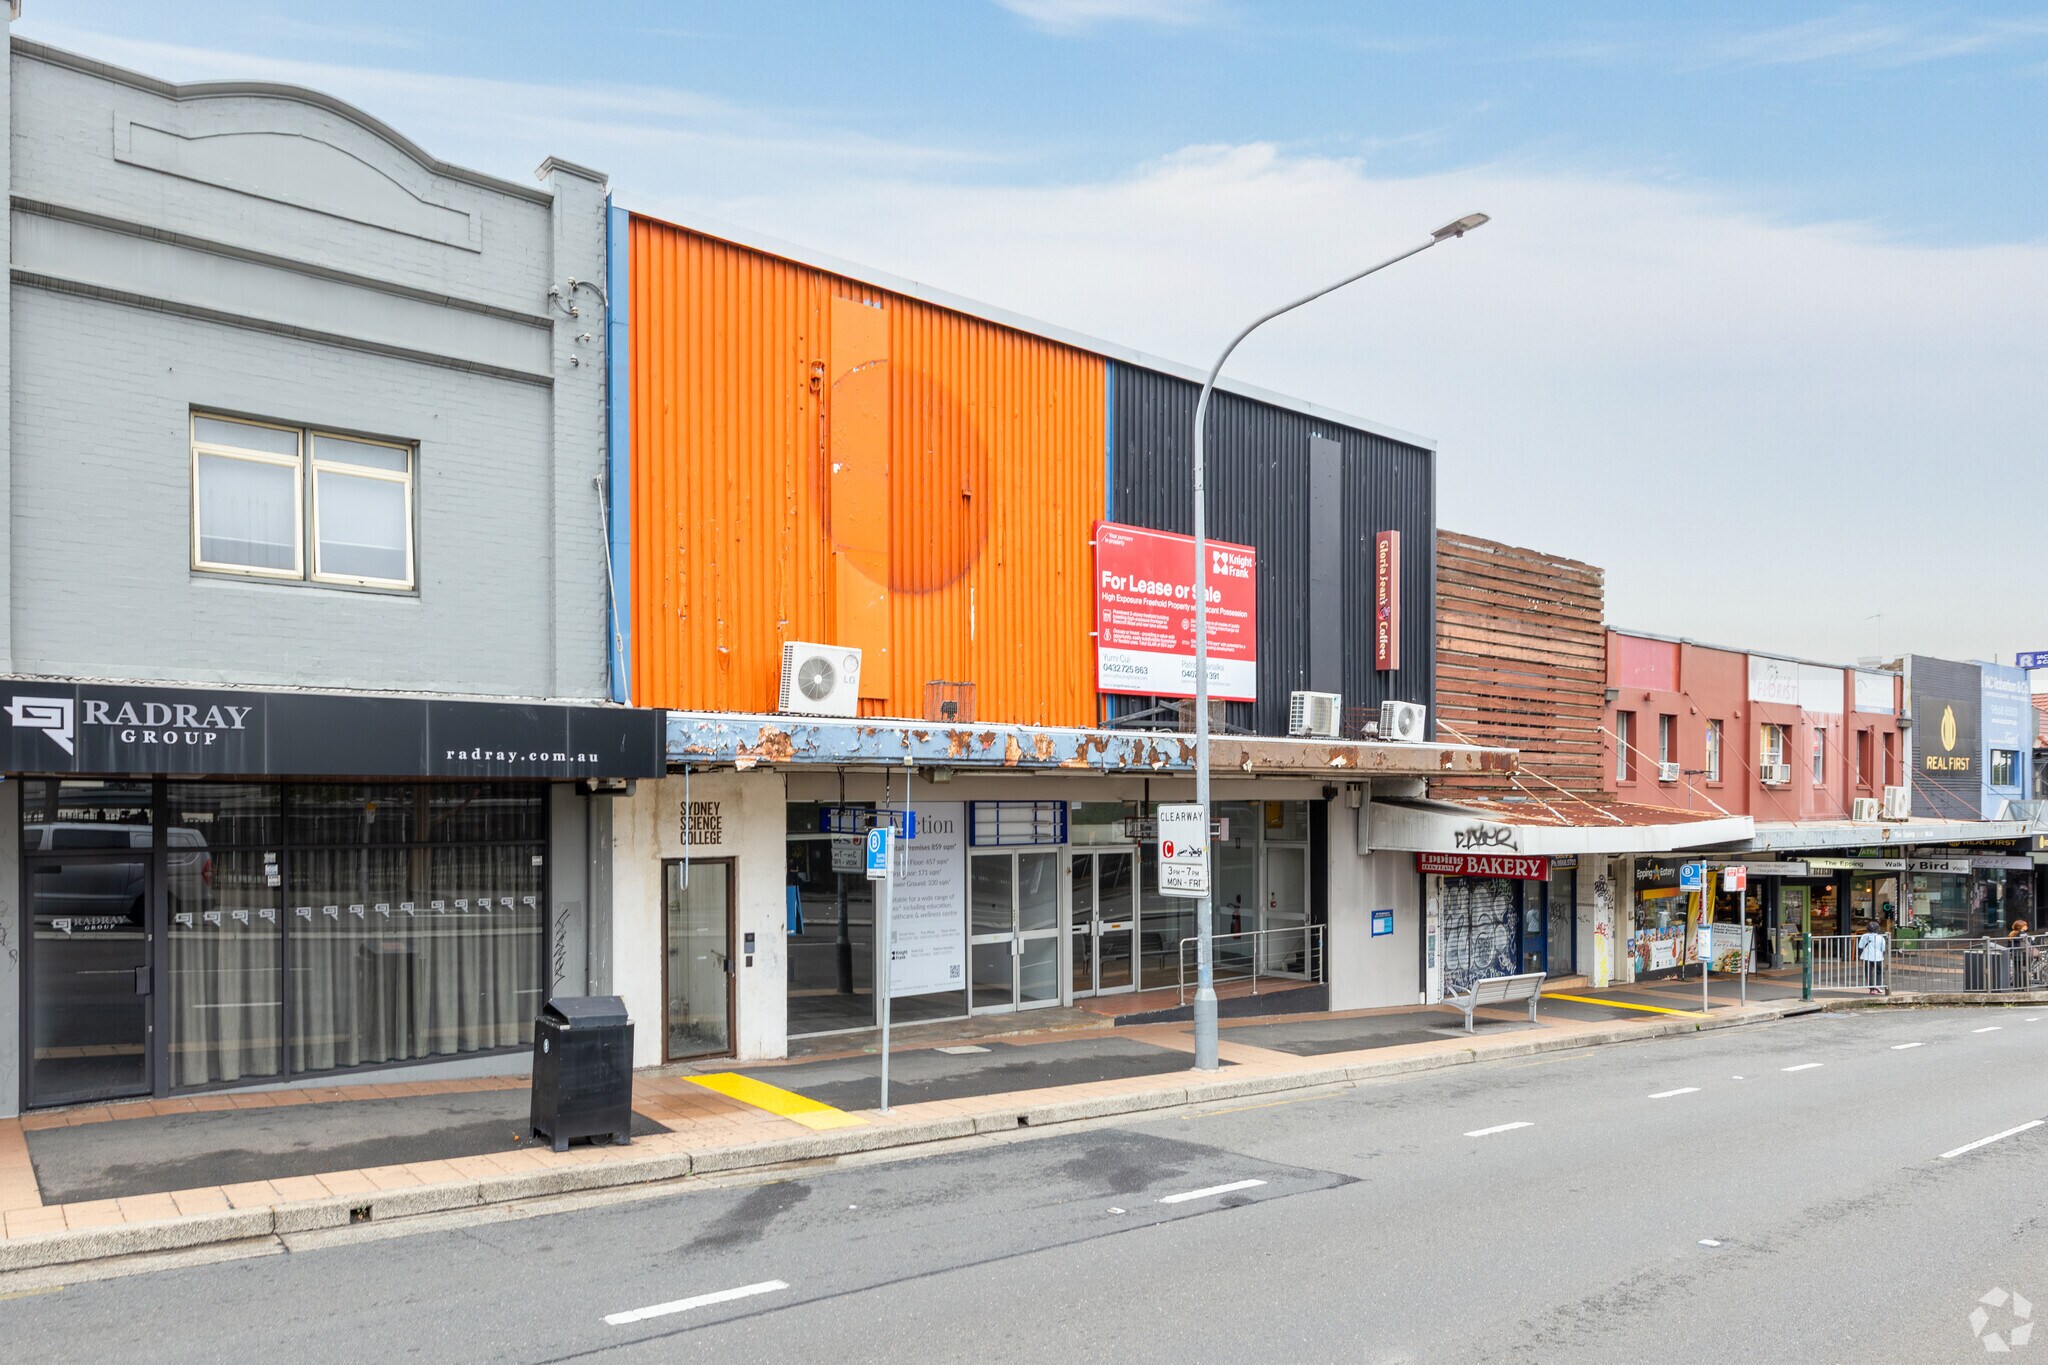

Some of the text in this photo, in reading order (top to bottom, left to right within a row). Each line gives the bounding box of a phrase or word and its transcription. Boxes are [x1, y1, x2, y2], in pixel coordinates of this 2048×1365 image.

[1229, 554, 1253, 568] Knight
[1380, 540, 1389, 574] Gloria
[1229, 566, 1249, 579] Frank
[1102, 570, 1127, 591] For
[1129, 575, 1173, 597] Lease
[1175, 585, 1189, 599] or
[1102, 592, 1116, 603] High
[1116, 594, 1143, 605] Exposure
[1143, 597, 1168, 608] Freehold
[1168, 601, 1190, 612] Property
[1220, 607, 1248, 618] Possession
[1380, 621, 1388, 660] Coffees
[1103, 663, 1120, 672] 0432
[1121, 664, 1134, 674] 725
[843, 675, 856, 684] LG
[1757, 681, 1797, 701] FLORIST
[83, 700, 253, 730] RADRAY
[121, 729, 217, 745] GROUP
[446, 748, 599, 763] radray.com.au
[1926, 756, 1970, 771] REAL FIRST
[680, 801, 721, 816] SYDNEY
[680, 816, 722, 830] SCIENCE
[1160, 811, 1203, 822] CLEARWAY
[680, 831, 722, 845] COLLEGE
[1168, 866, 1180, 875] 3PM
[1186, 867, 1200, 876] 7PM
[1466, 857, 1540, 877] BAKERY
[1840, 860, 1864, 868] Epping
[1920, 862, 1949, 870] Bird
[1637, 867, 1675, 880] Epping Eatery
[1167, 878, 1182, 887] MON
[1189, 879, 1202, 888] FRI
[74, 915, 126, 926] RADRAY
